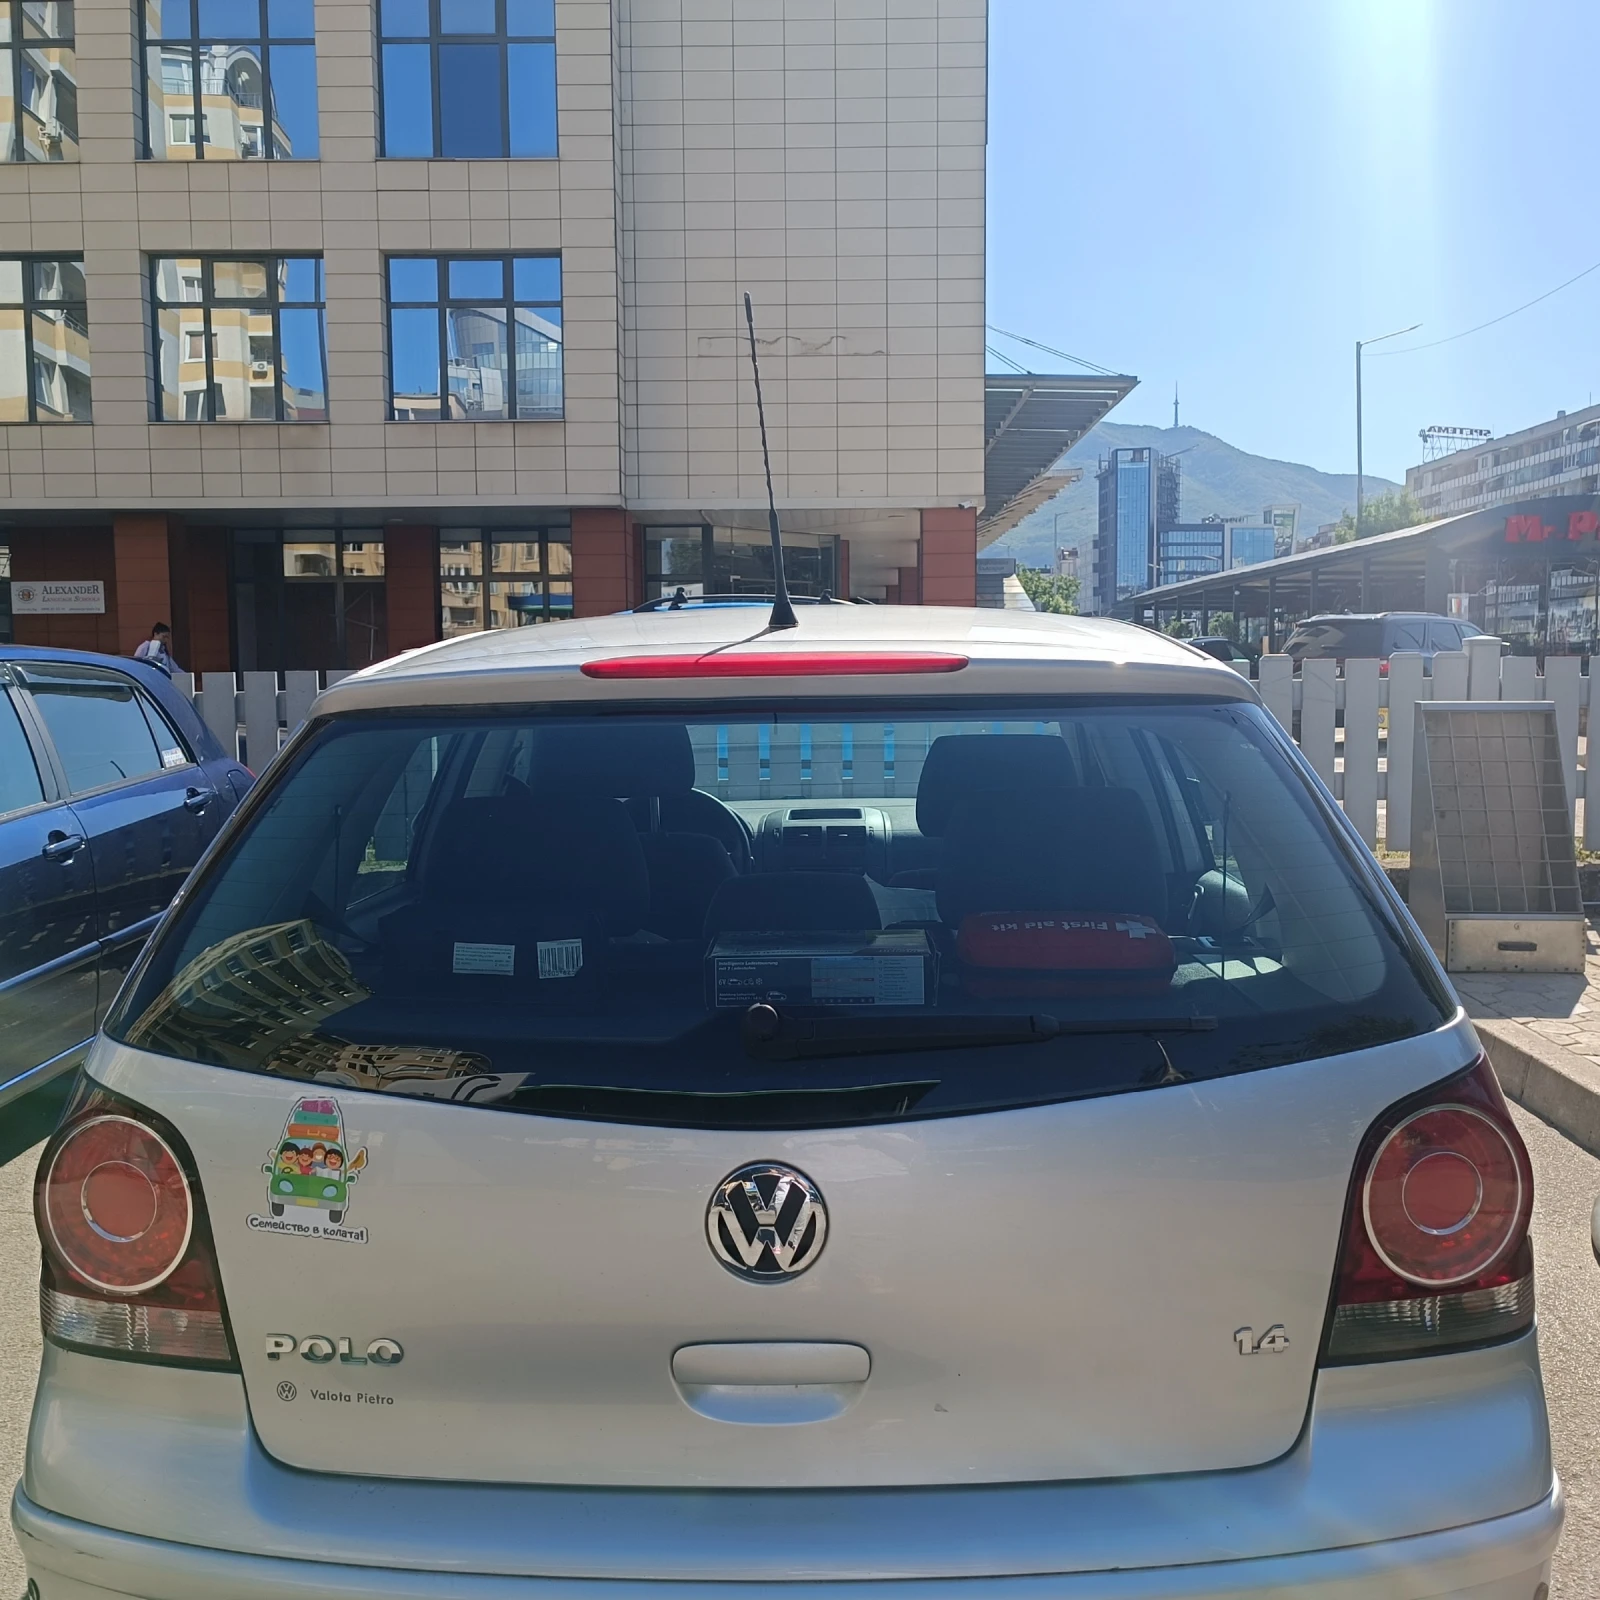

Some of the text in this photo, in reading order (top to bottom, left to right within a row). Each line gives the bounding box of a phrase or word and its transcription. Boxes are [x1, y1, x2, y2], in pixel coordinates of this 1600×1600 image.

[1568, 511, 1600, 541] P
[42, 585, 100, 594] ALEXANDER
[991, 920, 1108, 932] First aid kit
[249, 1217, 310, 1233] Семейство
[312, 1224, 319, 1234] в
[1233, 1323, 1290, 1355] 1.4
[266, 1333, 405, 1366] POLO
[310, 1389, 351, 1402] Valota
[357, 1392, 394, 1405] Pietro
